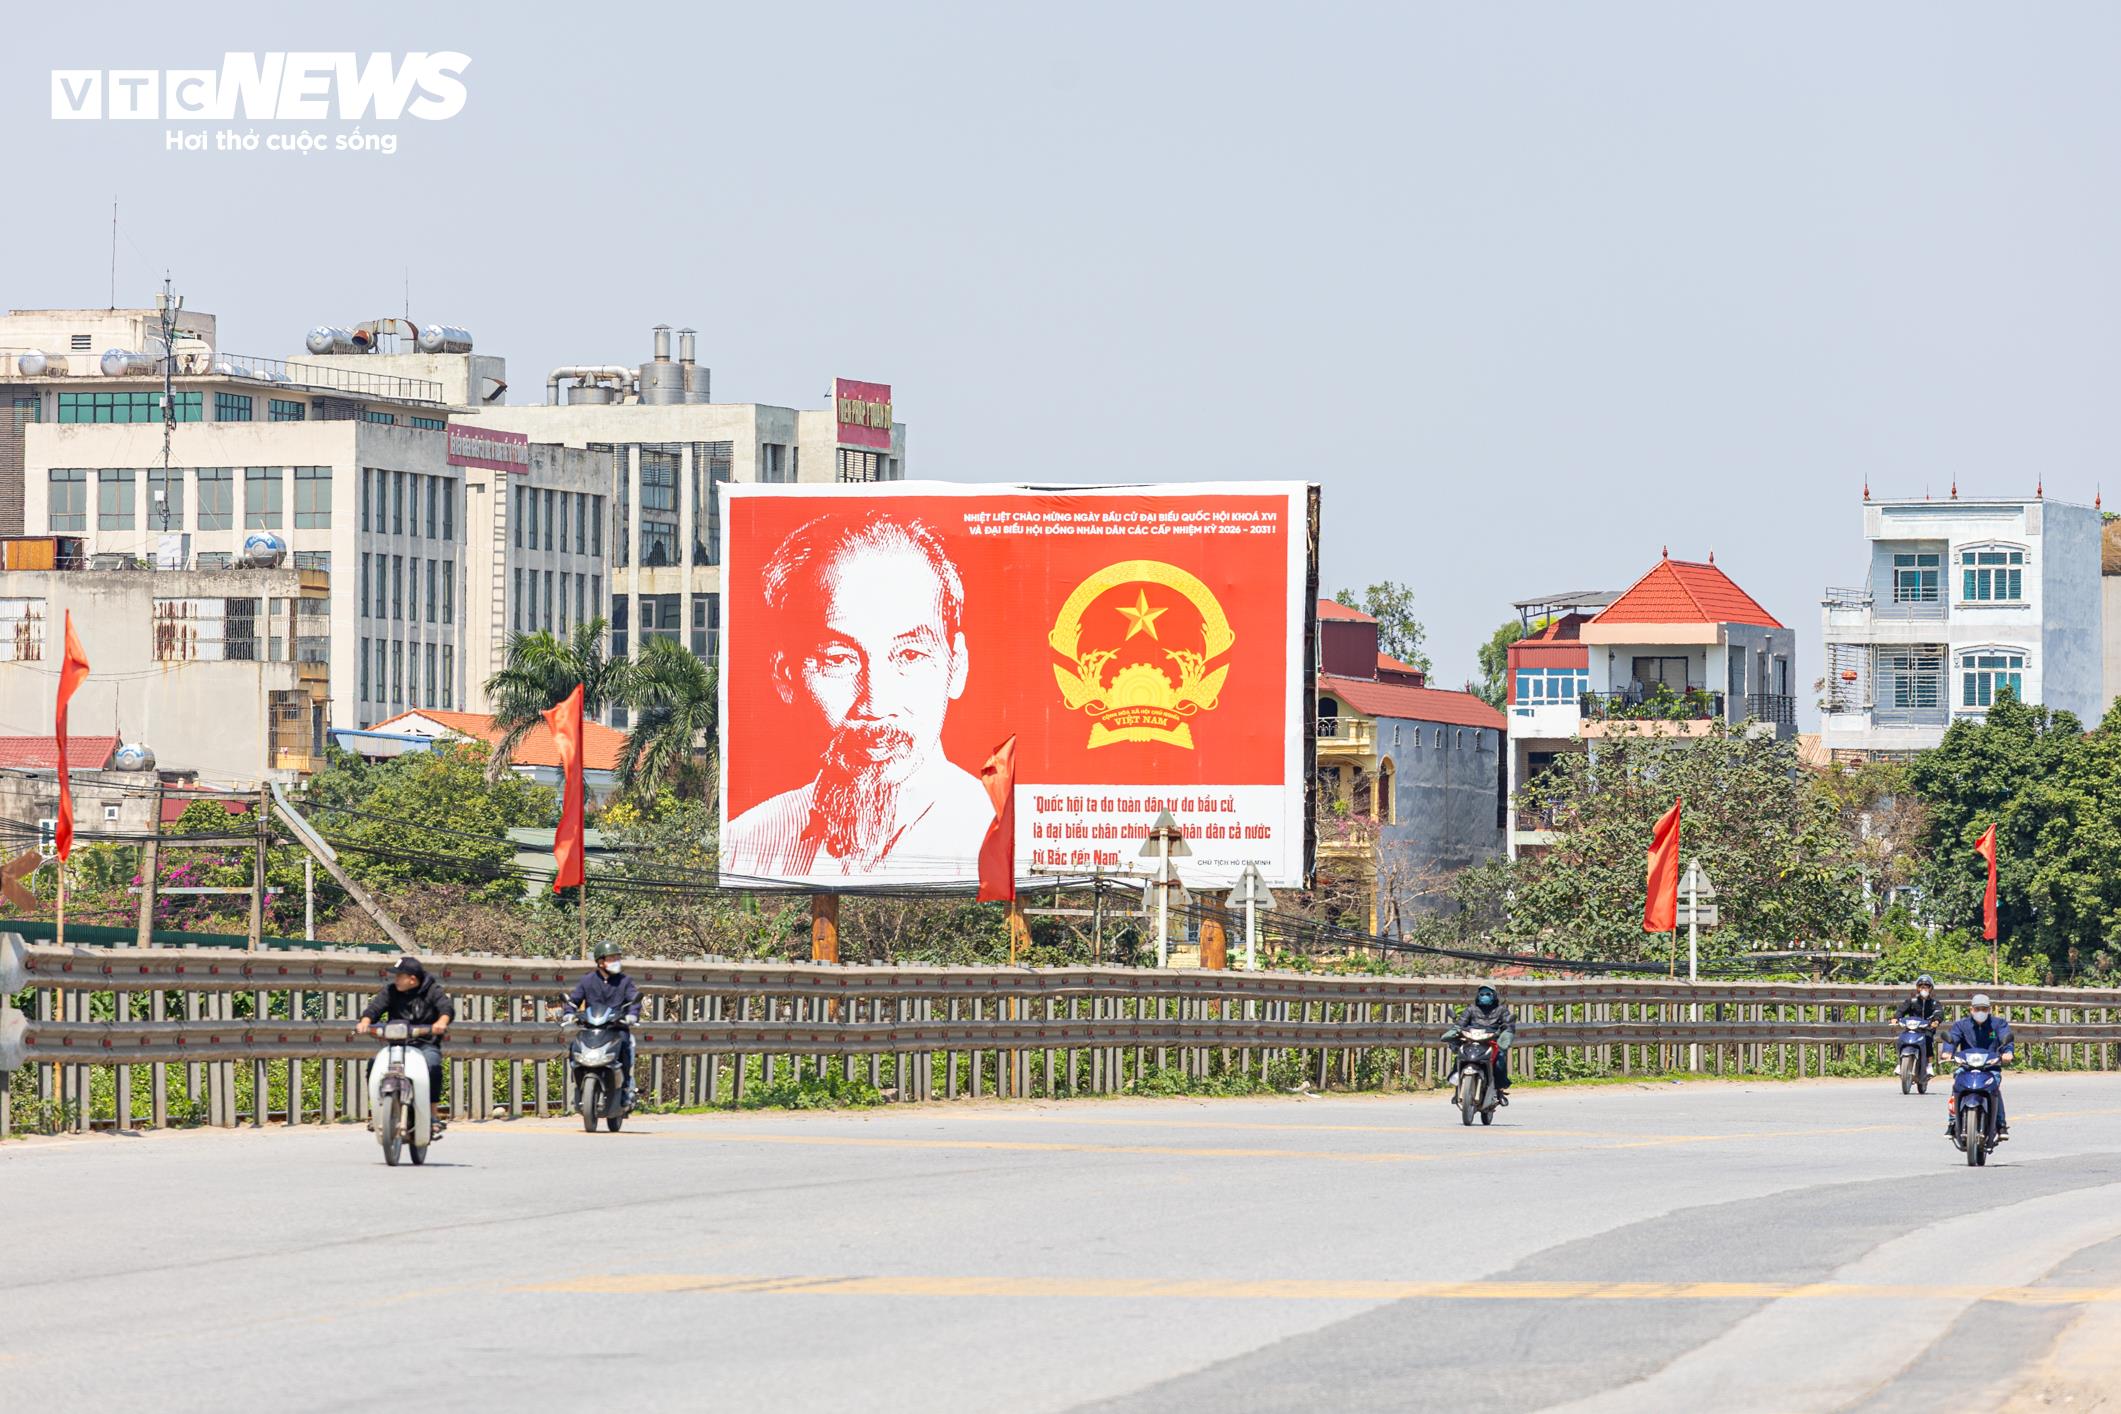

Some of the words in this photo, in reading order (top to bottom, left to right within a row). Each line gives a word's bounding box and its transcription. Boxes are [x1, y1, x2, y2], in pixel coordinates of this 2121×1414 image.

[963, 511, 992, 525] NHIỆT
[992, 511, 1012, 524] LIỆT
[1012, 511, 1042, 524] CHÀO
[1073, 511, 1101, 523] NGÀY
[1139, 512, 1157, 525] ĐẠI
[1181, 509, 1211, 523] QUỐC
[1212, 510, 1231, 524] HỘI
[1260, 511, 1277, 522] XVI
[968, 524, 983, 536] VÀ
[984, 525, 1002, 537] ĐẠI
[1025, 524, 1043, 537] HỘI
[1127, 524, 1149, 535] CÁC
[1172, 523, 1203, 537] NHIỆM
[1218, 525, 1242, 535] 2026
[1114, 715, 1140, 726] VIỆT
[1142, 715, 1168, 726] NAM
[1066, 796, 1084, 818] hội
[1086, 797, 1098, 814] ta
[1101, 796, 1115, 814] do
[1117, 796, 1142, 814] toàn
[1144, 796, 1164, 813] dân
[1167, 796, 1179, 817] tự
[1181, 796, 1195, 814] do
[1033, 822, 1043, 839] là
[1046, 823, 1062, 843] đại
[1065, 819, 1089, 839] biểu
[1091, 822, 1118, 839] chân
[1121, 822, 1151, 839] chính
[1206, 822, 1226, 839] dân
[1229, 821, 1242, 839] cả
[1245, 823, 1271, 839] nước
[1033, 848, 1045, 865] từ
[1047, 847, 1067, 866] Bắc
